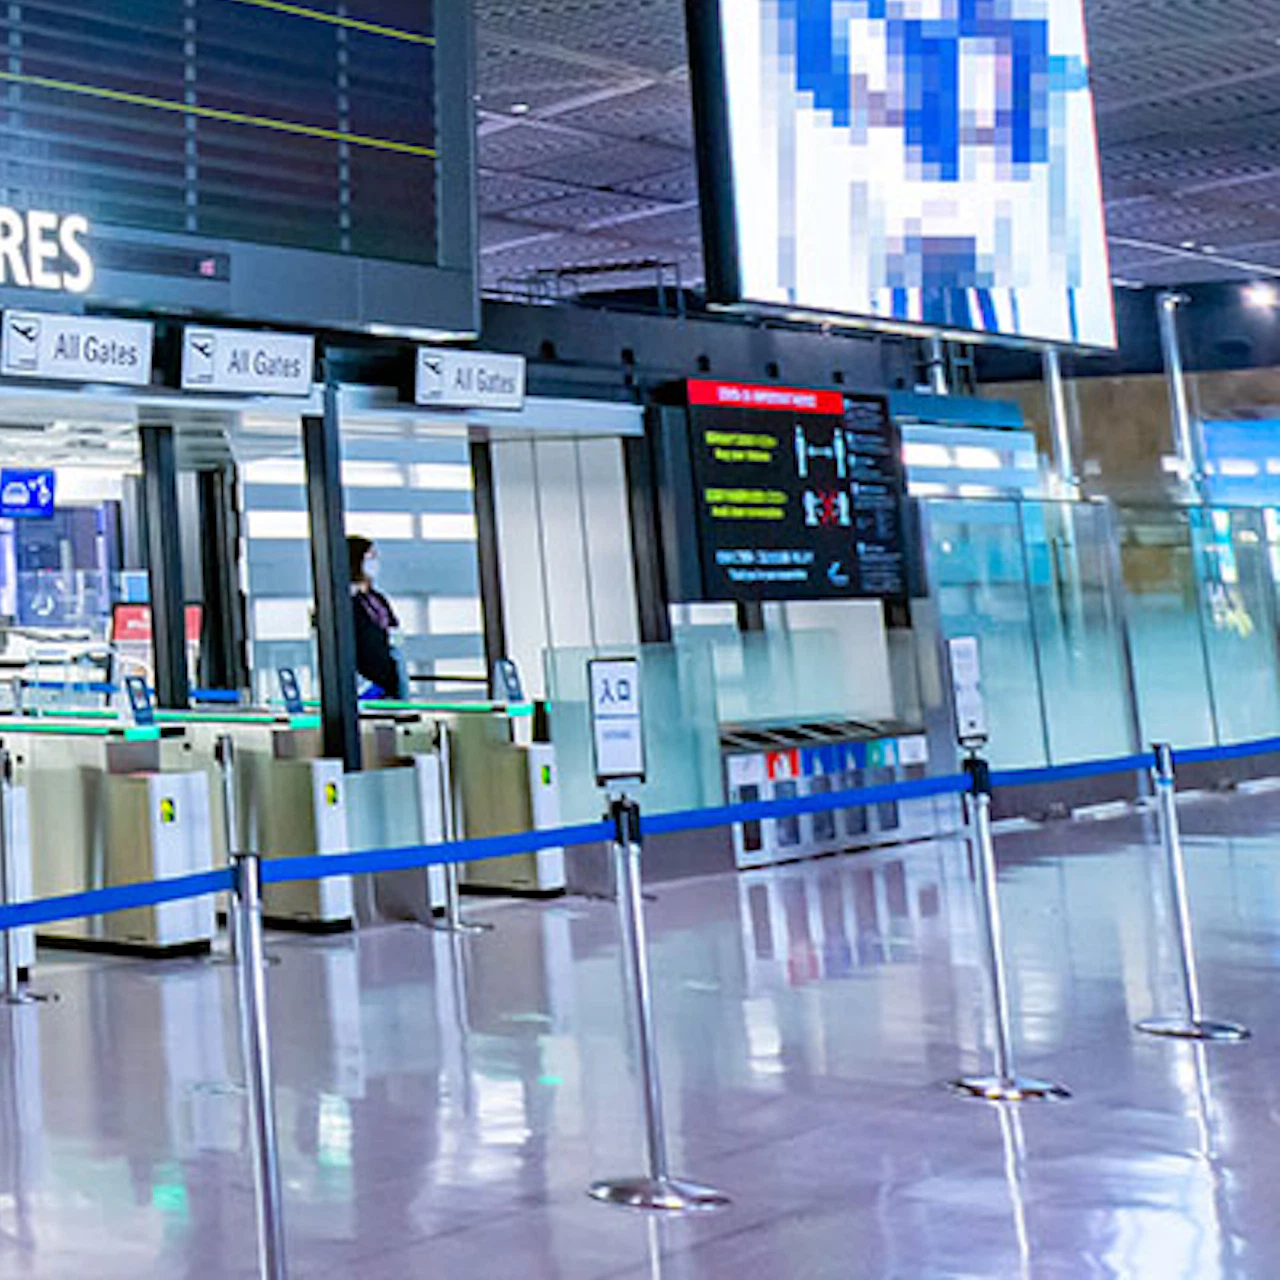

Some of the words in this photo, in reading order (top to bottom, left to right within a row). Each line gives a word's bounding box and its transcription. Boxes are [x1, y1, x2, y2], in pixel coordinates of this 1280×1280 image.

[53, 333, 80, 362] All
[84, 335, 139, 366] Gates
[227, 349, 251, 375] All
[253, 349, 302, 378] Gates
[454, 367, 473, 389] All
[476, 368, 515, 395] Gates
